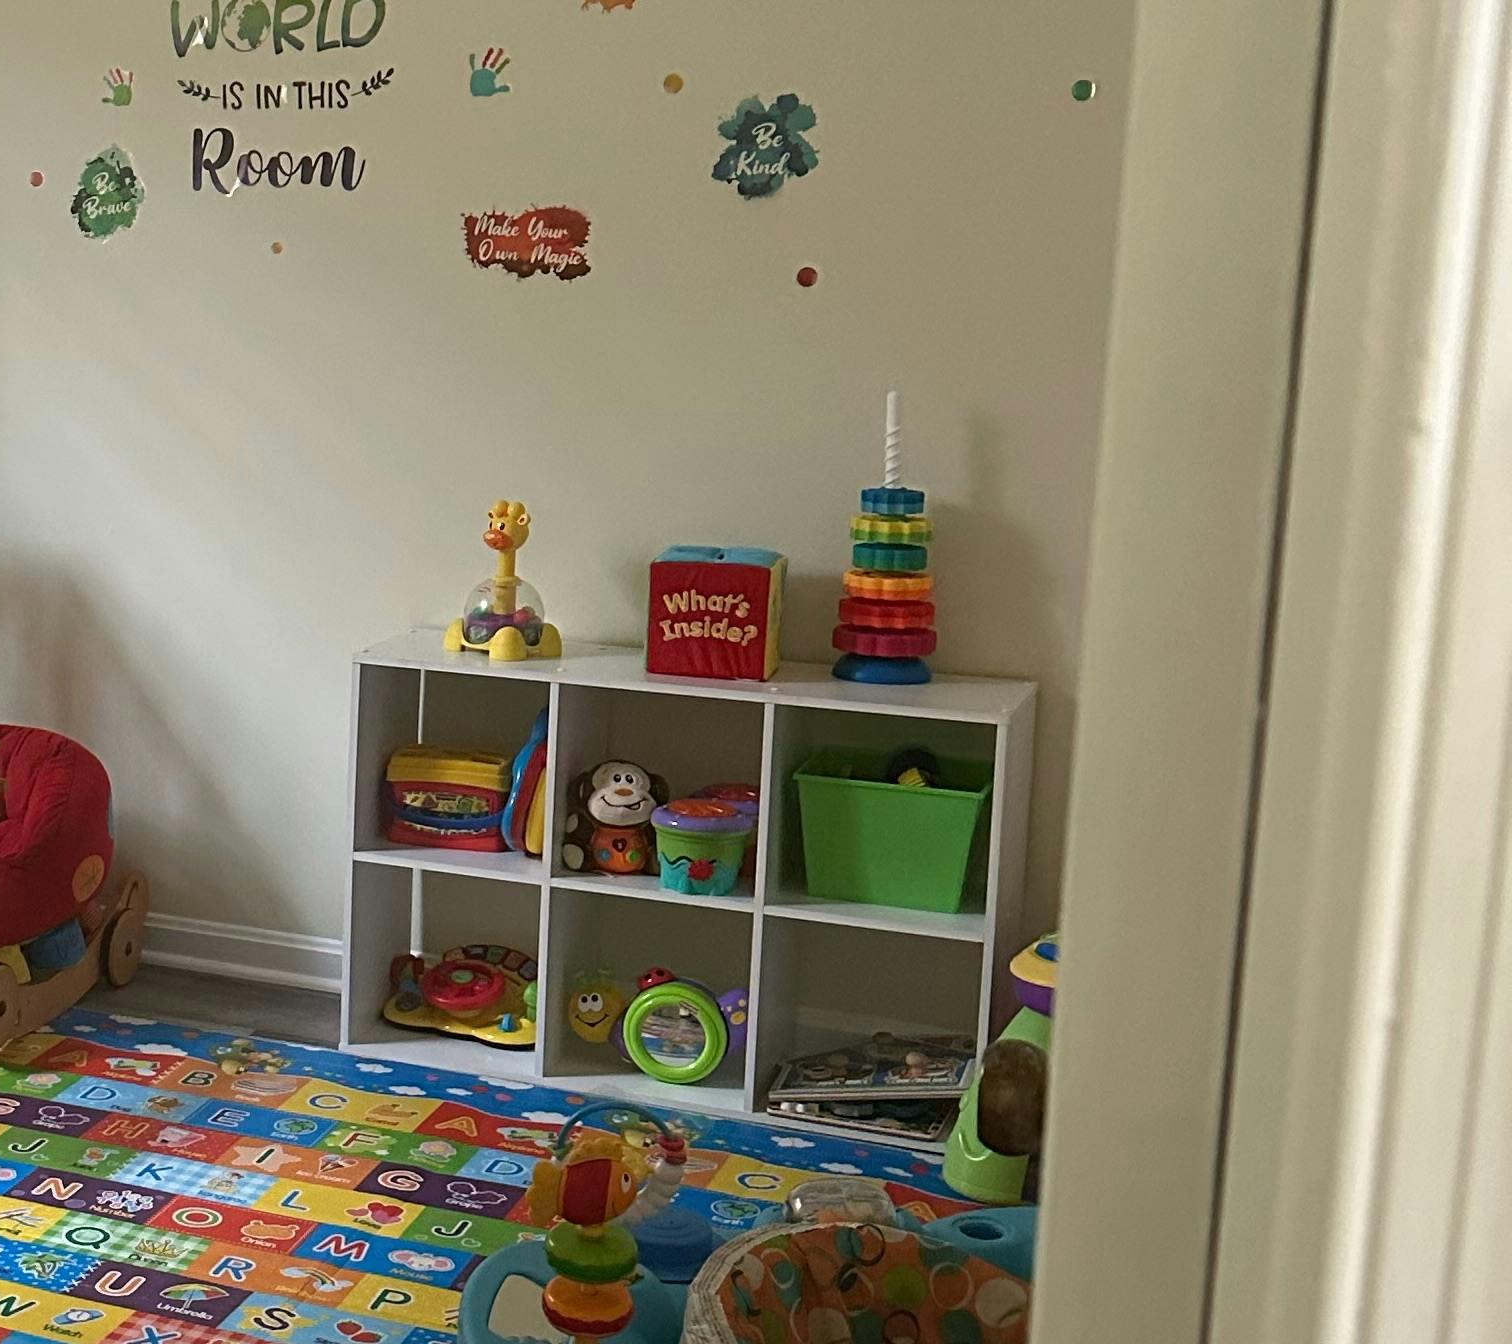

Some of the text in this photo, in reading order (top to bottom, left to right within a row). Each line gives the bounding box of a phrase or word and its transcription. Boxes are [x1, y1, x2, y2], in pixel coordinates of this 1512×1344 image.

[222, 79, 351, 110] IS IN THIS
[751, 122, 784, 150] Be
[192, 127, 367, 195] Room
[737, 151, 791, 176] Kind
[92, 171, 120, 195] Be
[82, 196, 133, 220] Brave
[474, 215, 569, 242] Make Your
[530, 243, 585, 273] Magic
[663, 588, 751, 619] What's
[659, 616, 759, 647] Inside?
[178, 1070, 218, 1088] B
[78, 1084, 118, 1102] D
[306, 1092, 350, 1110] C
[102, 1119, 150, 1139] H
[207, 1107, 251, 1128] E
[434, 1116, 478, 1138] A
[7, 1137, 49, 1155] J
[340, 1131, 381, 1149] F
[136, 1161, 175, 1182] K
[483, 1158, 527, 1177] D
[31, 1177, 85, 1201] N
[377, 1170, 426, 1192] G
[736, 1171, 784, 1192] C
[279, 1188, 312, 1214] L
[172, 1207, 224, 1229] O
[431, 1218, 472, 1239] J
[63, 1225, 112, 1250] Q
[313, 1233, 370, 1262] M
[208, 1256, 256, 1284] R
[94, 1269, 147, 1298] U
[156, 1301, 215, 1321] Umbrella
[368, 1287, 413, 1312] P
[250, 1305, 297, 1332] S
[42, 1322, 84, 1340] Watch
